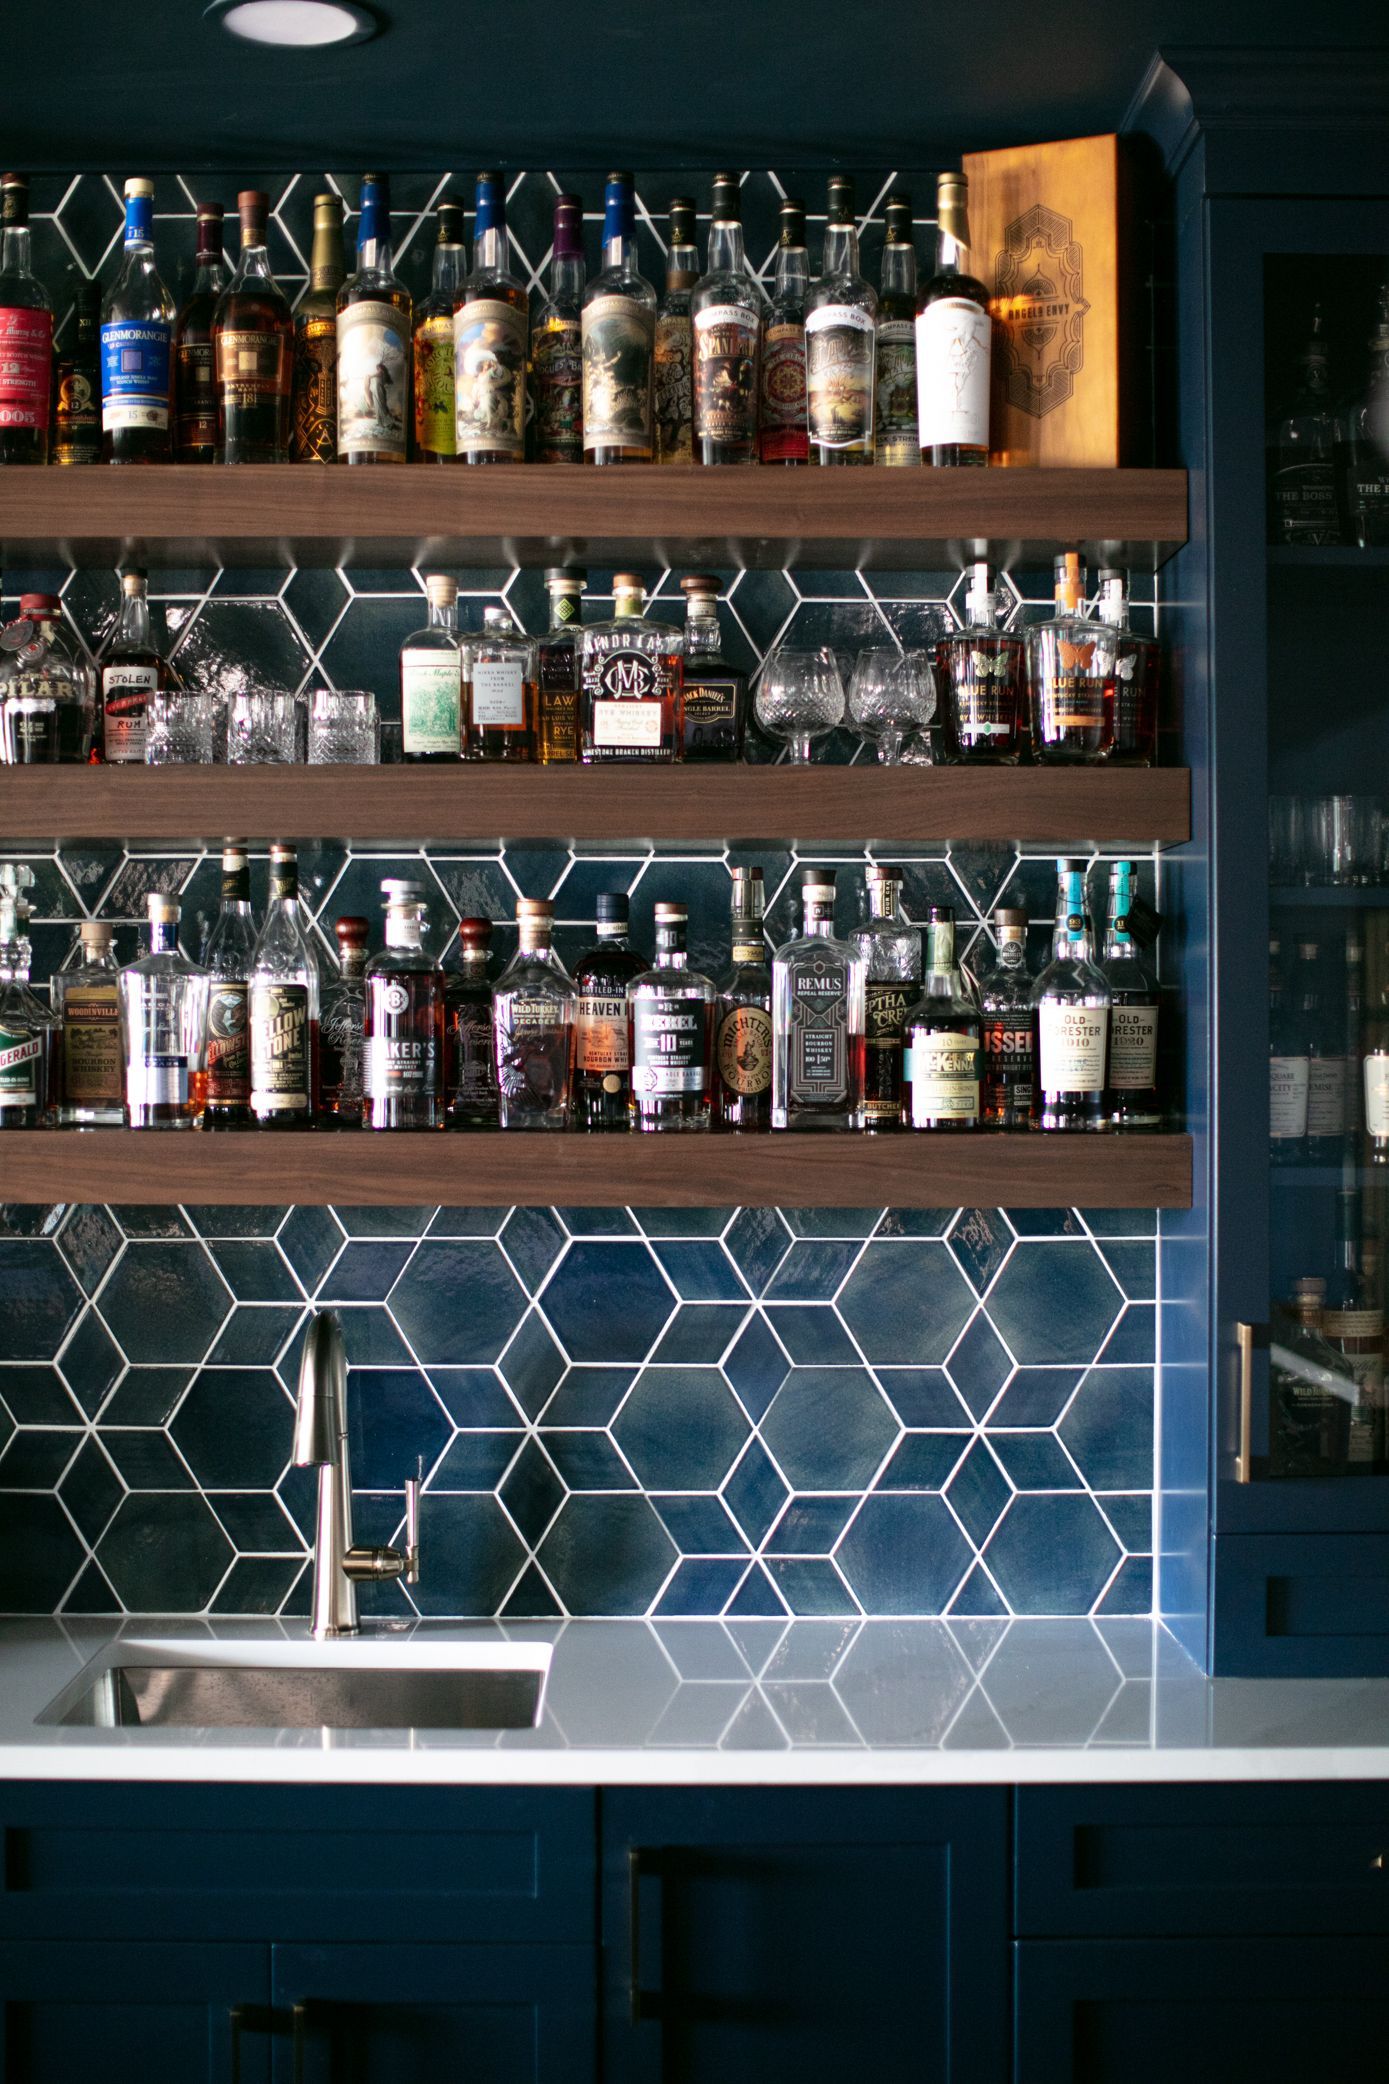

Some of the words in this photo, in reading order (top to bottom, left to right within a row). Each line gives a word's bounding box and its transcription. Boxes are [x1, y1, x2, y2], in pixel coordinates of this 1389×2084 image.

[1046, 304, 1070, 316] ENVY
[850, 313, 866, 325] BOX
[879, 322, 908, 335] COMPASS
[102, 329, 169, 344] GLENMORANGIE
[221, 335, 278, 346] GLENMORANGIE
[1, 362, 21, 374] 12
[0, 410, 35, 424] 005
[128, 410, 138, 419] 15
[892, 433, 919, 443] STREN
[1356, 484, 1382, 493] THE
[1276, 491, 1298, 501] THE
[1302, 491, 1333, 501] BOSS
[584, 633, 631, 654] MINOR
[109, 674, 151, 685] STOLEN
[1079, 678, 1104, 688] RUN
[991, 685, 1015, 696] RUN
[1122, 686, 1147, 698] RUN
[545, 696, 574, 707] LAW
[117, 720, 141, 729] RUM
[553, 726, 574, 735] RYE
[615, 748, 639, 756] BRANCH
[797, 977, 842, 990] REMUS
[581, 986, 627, 995] BOTTLED-IN-
[512, 1003, 531, 1014] WILD
[532, 1003, 560, 1014] TURKEY
[580, 1001, 620, 1017] HEAVEN
[865, 992, 907, 1016] EPTHA
[873, 1008, 908, 1028] CRE
[1064, 1014, 1086, 1025] OLD
[1118, 1014, 1139, 1023] OLD
[1059, 1026, 1101, 1037] RESTER
[1112, 1025, 1153, 1036] RESTER
[266, 1027, 300, 1060] TONE
[660, 1034, 677, 1053] 10
[942, 1038, 953, 1047] 10
[0, 1041, 39, 1067] GERALD
[385, 1041, 435, 1058] AKER'S
[723, 1063, 771, 1088] BOURBO
[1271, 1073, 1295, 1081] QUARE
[1015, 1085, 1032, 1094] SING
[1309, 1083, 1332, 1091] EMISE
